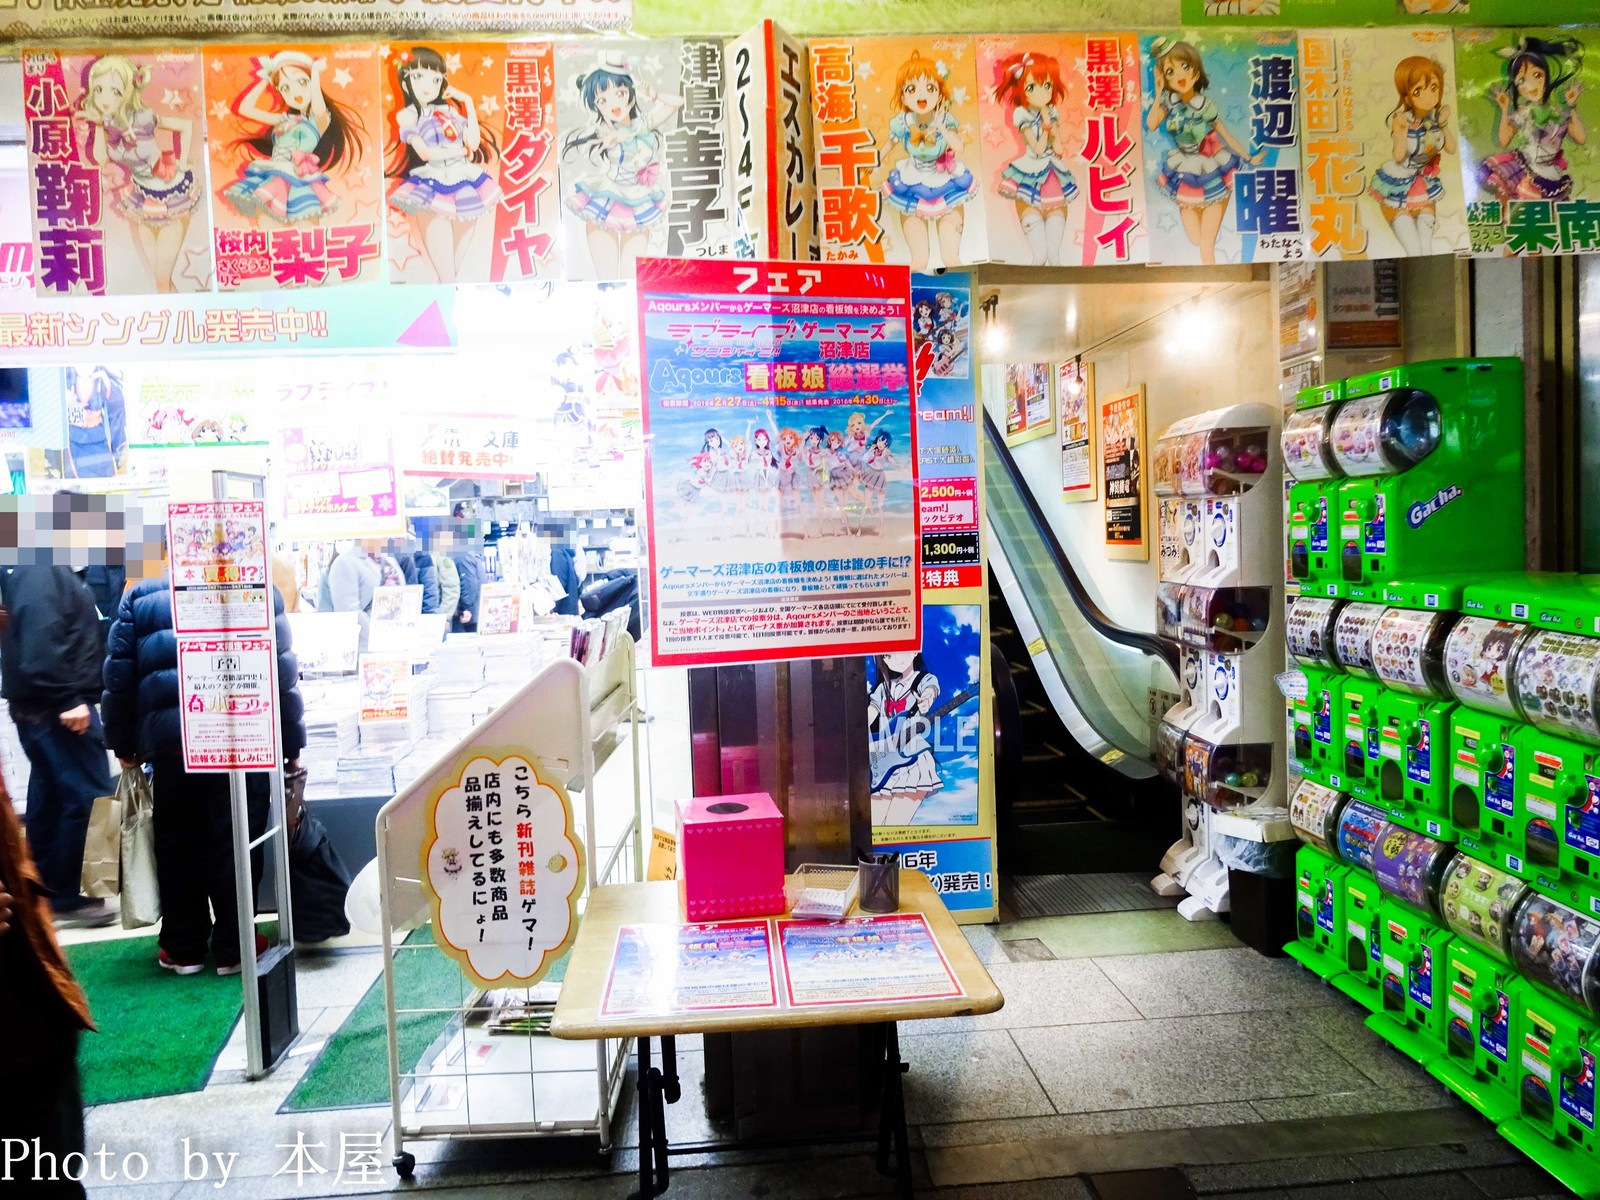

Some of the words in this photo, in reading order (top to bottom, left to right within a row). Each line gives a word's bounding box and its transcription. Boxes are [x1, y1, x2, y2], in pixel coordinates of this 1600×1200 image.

[1249, 54, 1297, 150] 渡辺
[500, 58, 555, 279] 黒澤ダイヤ
[664, 43, 727, 246] 津島善子
[812, 45, 883, 248] 高海千歌
[1081, 38, 1136, 262] 黒澤ルビィ
[1302, 36, 1369, 256] 国木田花丸
[26, 76, 108, 295] 小原鞠莉
[1233, 168, 1303, 236] 曜
[1504, 198, 1600, 254] 果南
[217, 228, 268, 257] 桜内
[269, 223, 382, 287] 梨子
[217, 257, 272, 274] さくらうち
[695, 244, 729, 258] つしま
[825, 250, 860, 262] たかみ
[1282, 249, 1304, 260] よう
[218, 273, 242, 288] りこ
[732, 266, 822, 295] フェア
[0, 307, 329, 348] 最新シングル発売中!!
[647, 299, 900, 316] Aqoursメンバーからゲーマーズ沼津店の看板娘を決めよう!
[801, 321, 886, 340] ゲーマーズ
[818, 340, 871, 360] 沼津店
[649, 358, 743, 394] Aqours
[923, 513, 964, 523] ックビデオ
[659, 555, 912, 579] ゲーマーズ沼津店の看板娘の座は誰の手に!?
[464, 776, 487, 943] 品揃えしてるにょ!
[484, 772, 509, 922] 店内にも多数商品
[513, 765, 538, 951] こちら新刊雑誌ゲマ!
